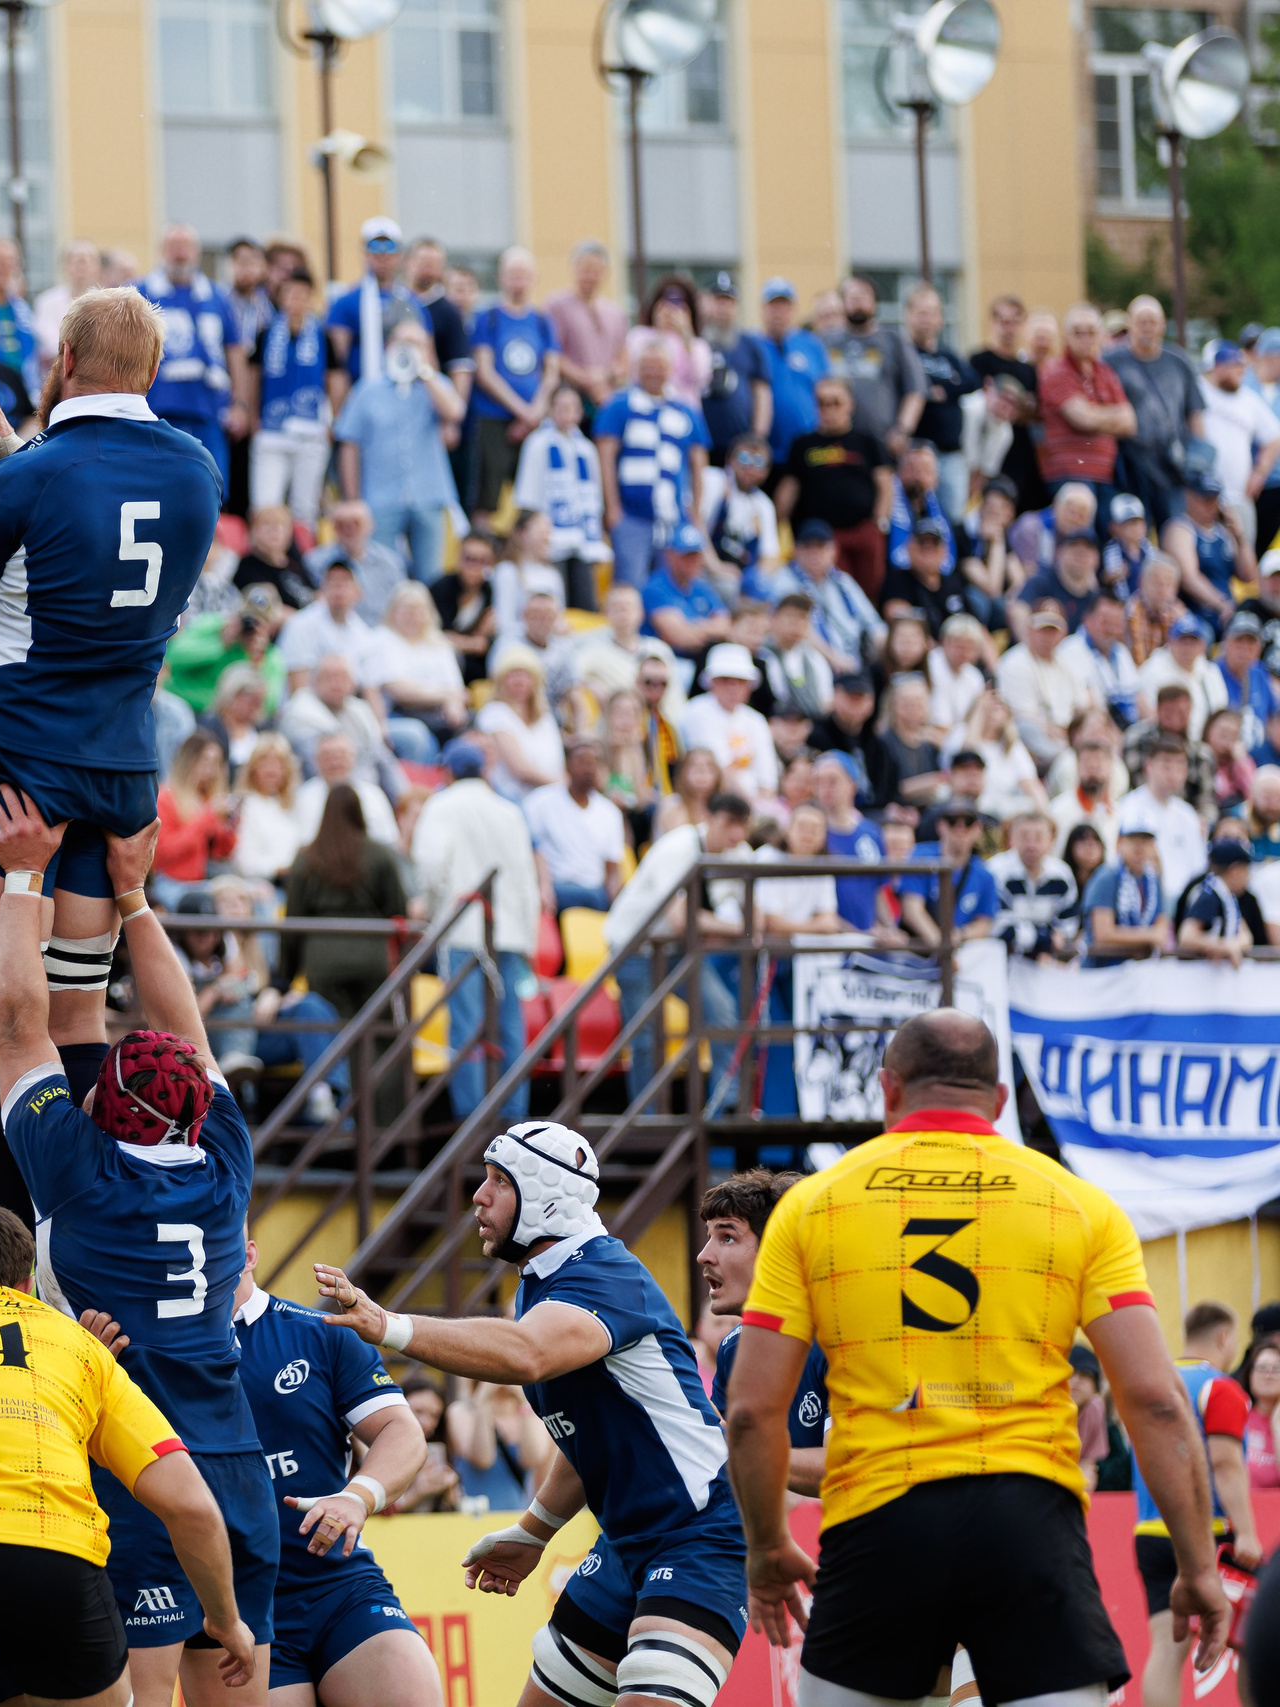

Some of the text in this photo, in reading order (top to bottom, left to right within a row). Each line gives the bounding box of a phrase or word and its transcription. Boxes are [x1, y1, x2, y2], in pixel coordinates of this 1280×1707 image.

[110, 501, 161, 608] 5
[157, 1223, 205, 1319] 3
[900, 1218, 980, 1332] 3
[265, 1450, 299, 1480] ТБ
[125, 1611, 185, 1626] ARBATHALL
